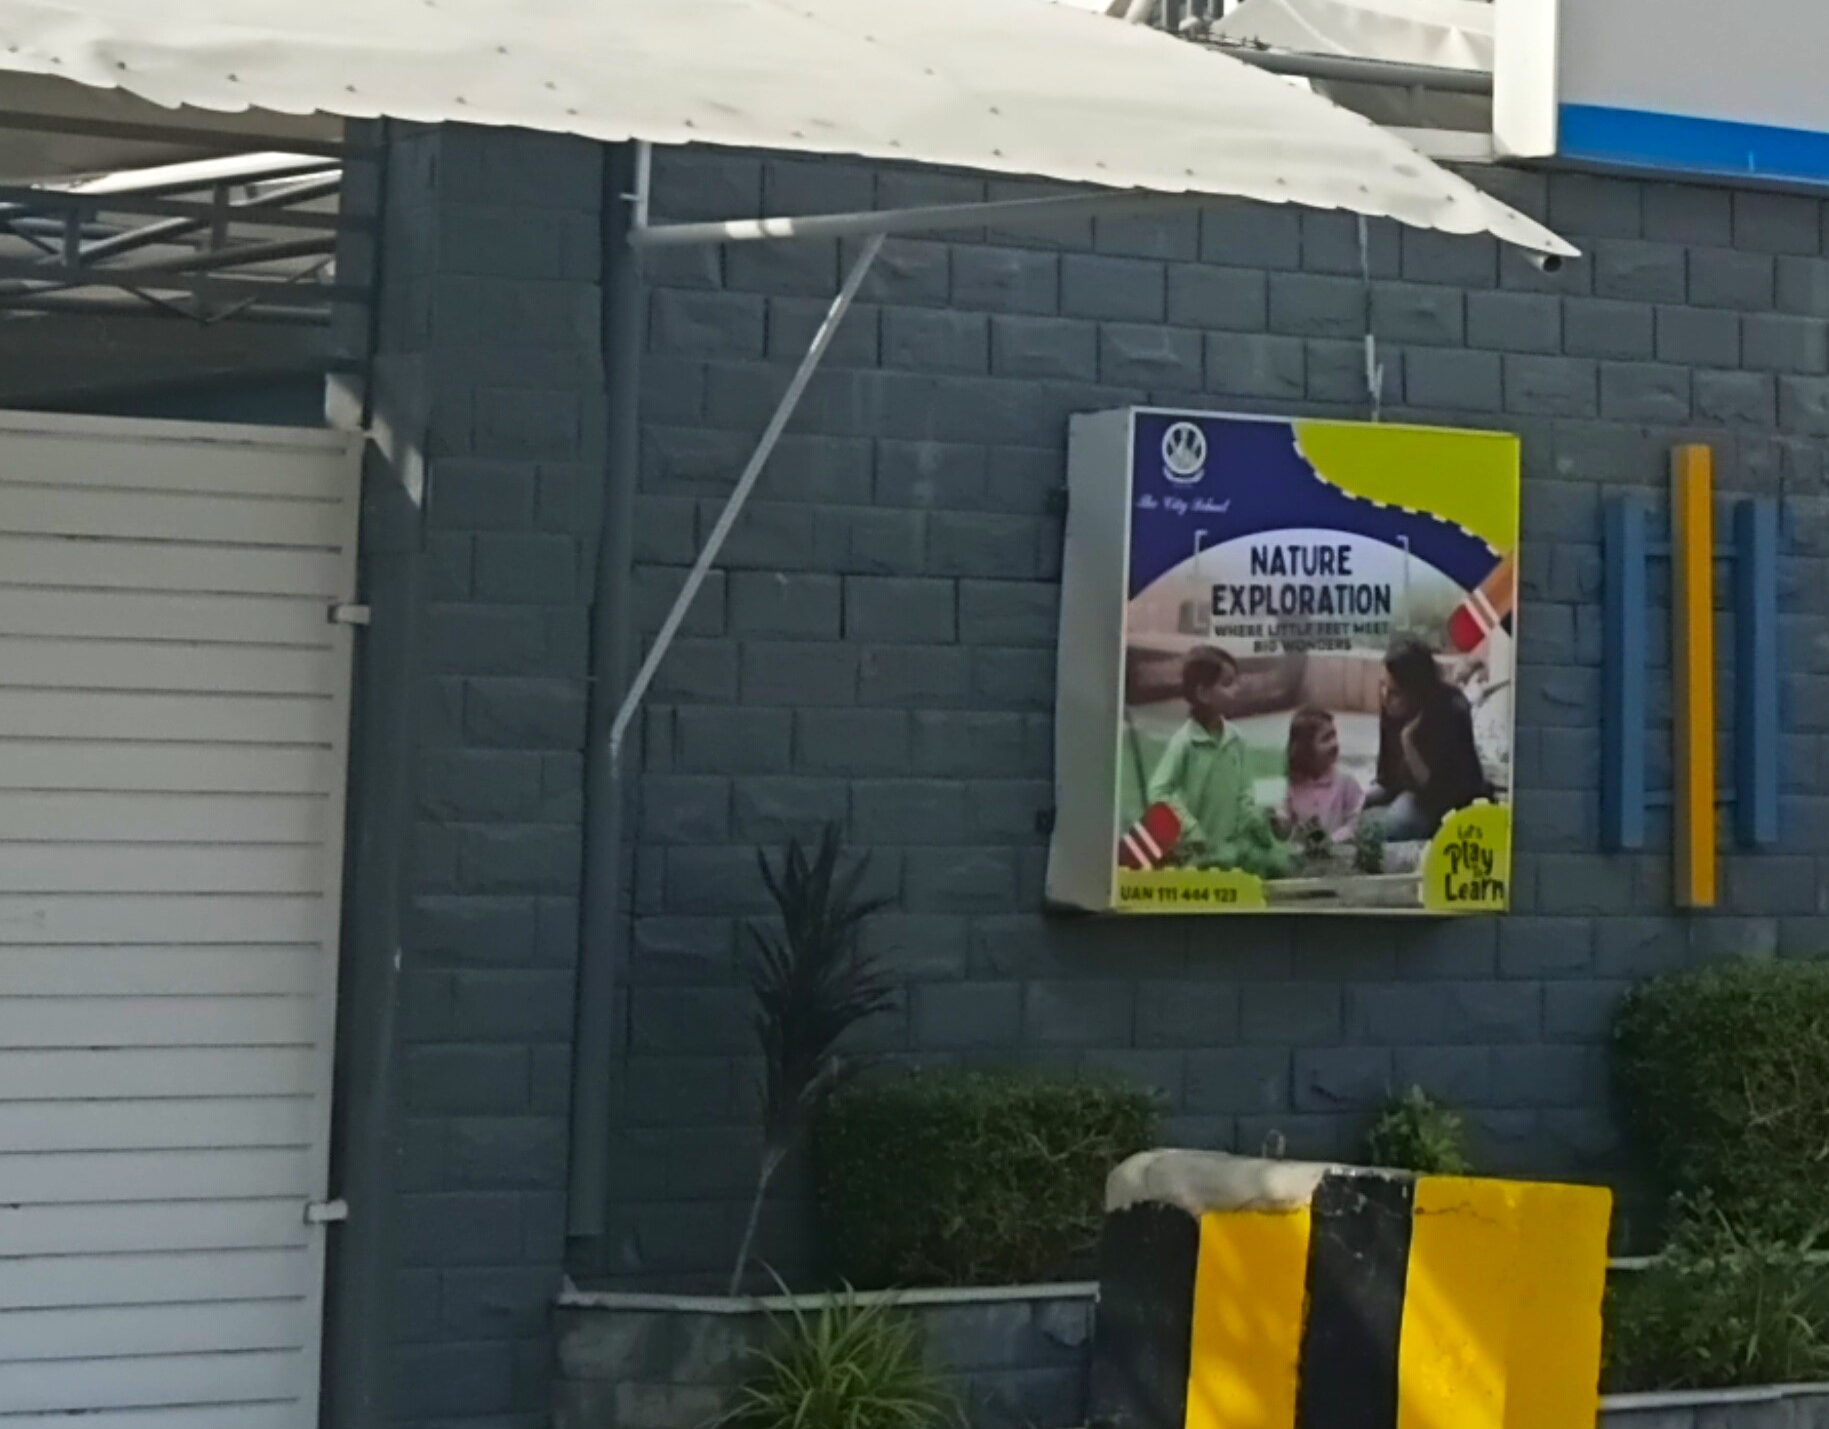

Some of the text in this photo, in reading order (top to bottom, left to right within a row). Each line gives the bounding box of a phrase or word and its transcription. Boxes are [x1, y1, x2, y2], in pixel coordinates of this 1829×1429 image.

[1250, 544, 1353, 577] NATURE
[1212, 583, 1391, 616] EXPLORATION
[1443, 841, 1493, 875] Play
[1121, 885, 1153, 901] UAN
[1445, 873, 1504, 901] Learn
